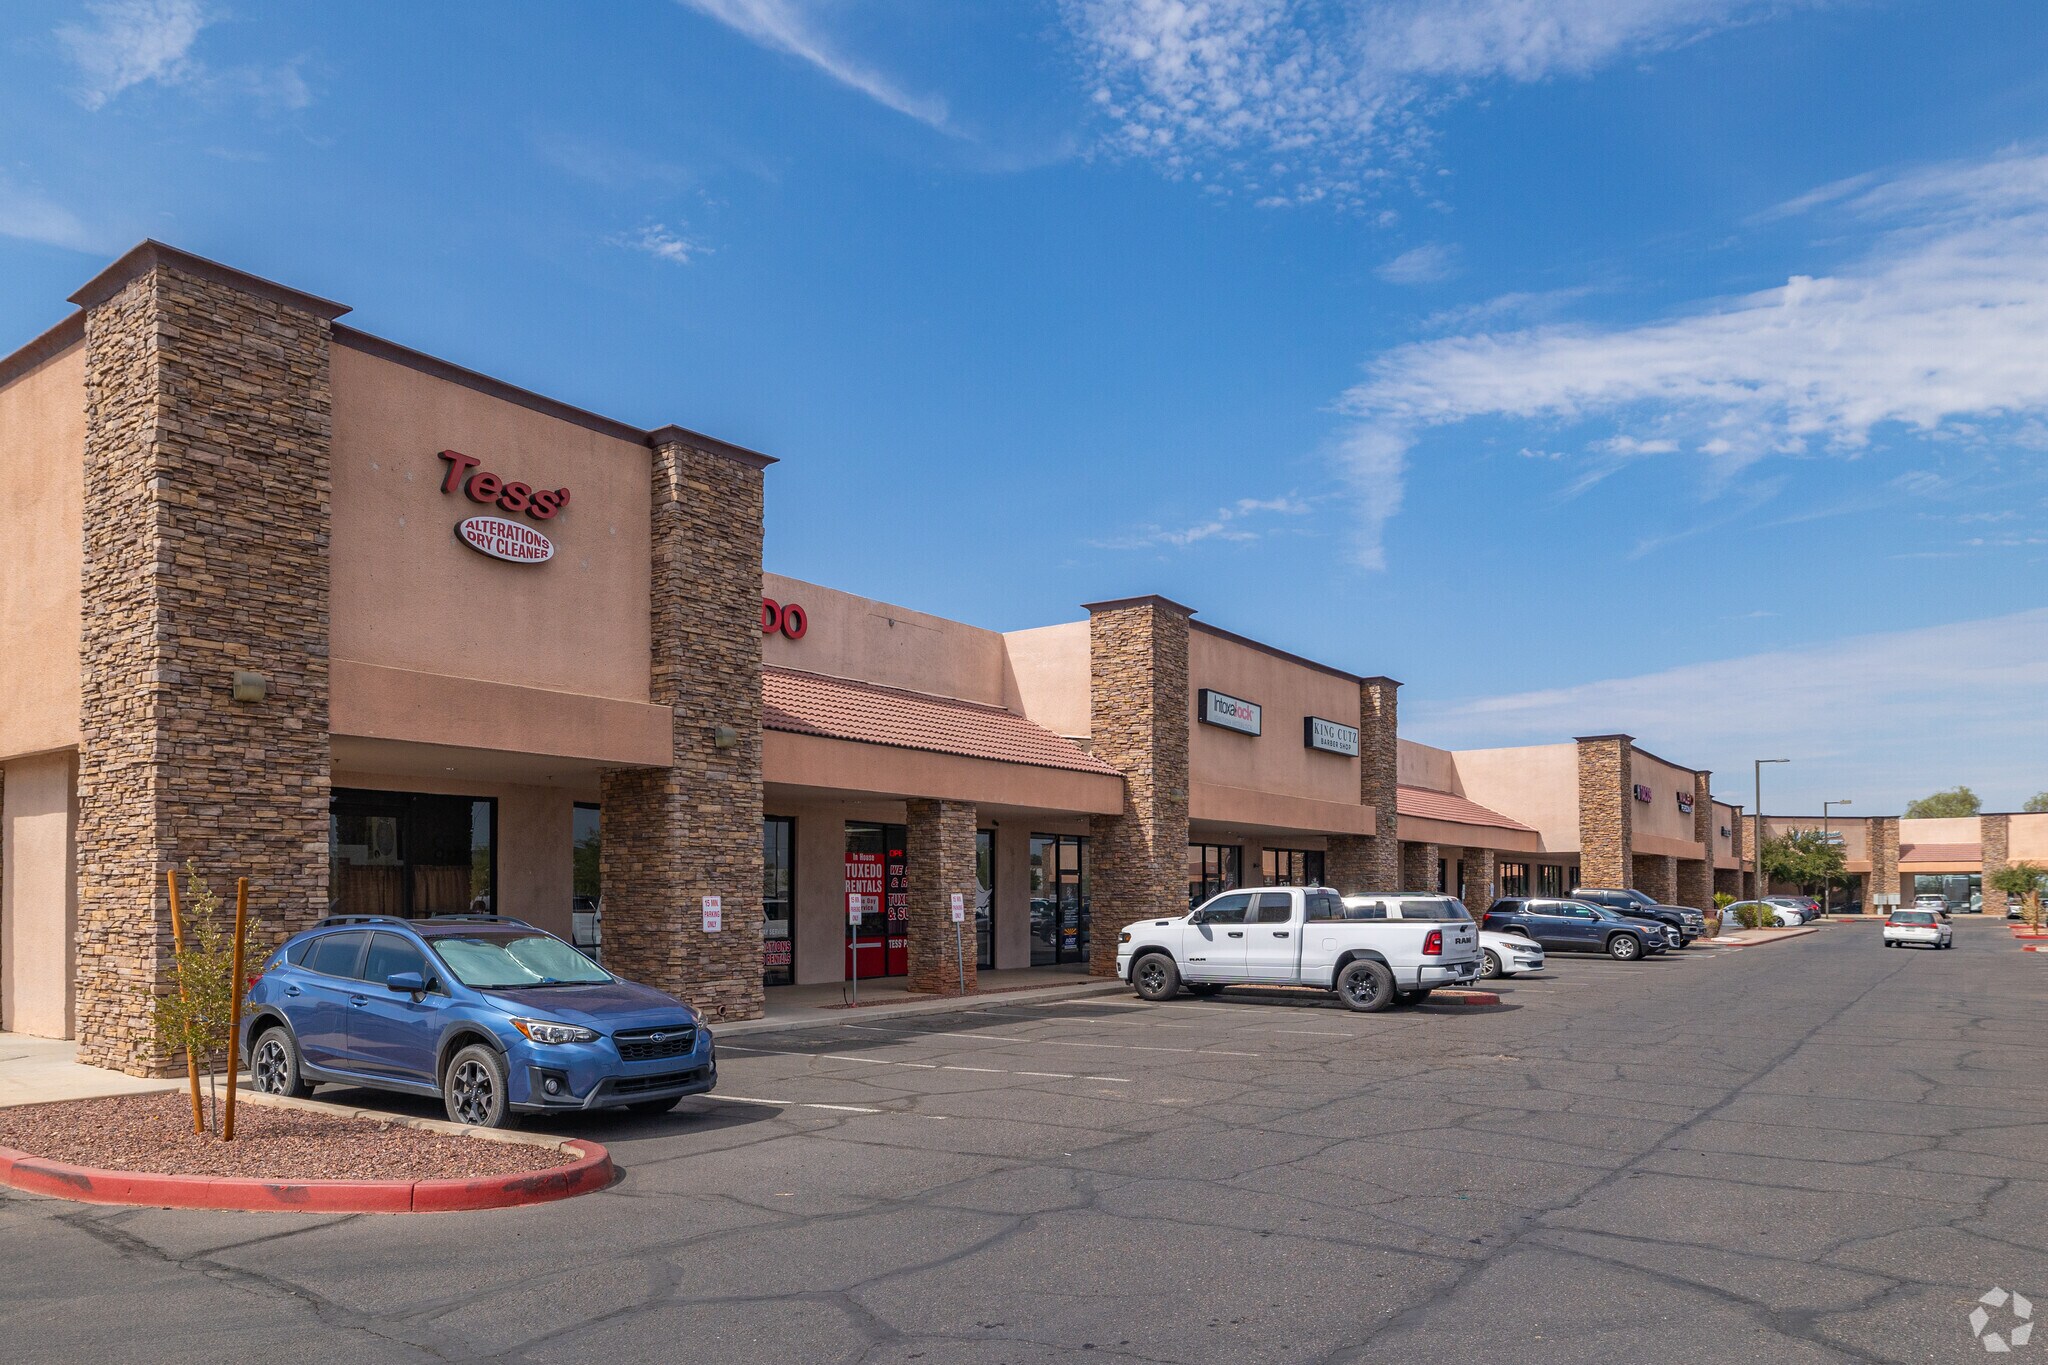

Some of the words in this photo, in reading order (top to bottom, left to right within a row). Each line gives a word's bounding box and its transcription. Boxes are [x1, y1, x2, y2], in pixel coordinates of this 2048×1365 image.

[465, 520, 550, 550] ALTERATIONS
[466, 530, 493, 550] DRY
[496, 538, 549, 559] CLEANER
[1214, 695, 1253, 721] Intoxalock
[1314, 722, 1334, 739] KING
[1337, 728, 1357, 744] CUTZ
[1320, 738, 1338, 748] BARBER
[1339, 742, 1352, 751] SHOP
[853, 853, 858, 861] In
[860, 853, 874, 861] House
[846, 863, 882, 878] TUXEDO
[890, 864, 904, 876] WE
[845, 880, 882, 892] RENTALS
[704, 899, 711, 907] 15
[866, 897, 877, 905] Day
[888, 907, 897, 921] &
[1454, 937, 1472, 945] RAM
[766, 953, 791, 965] RENTALS
